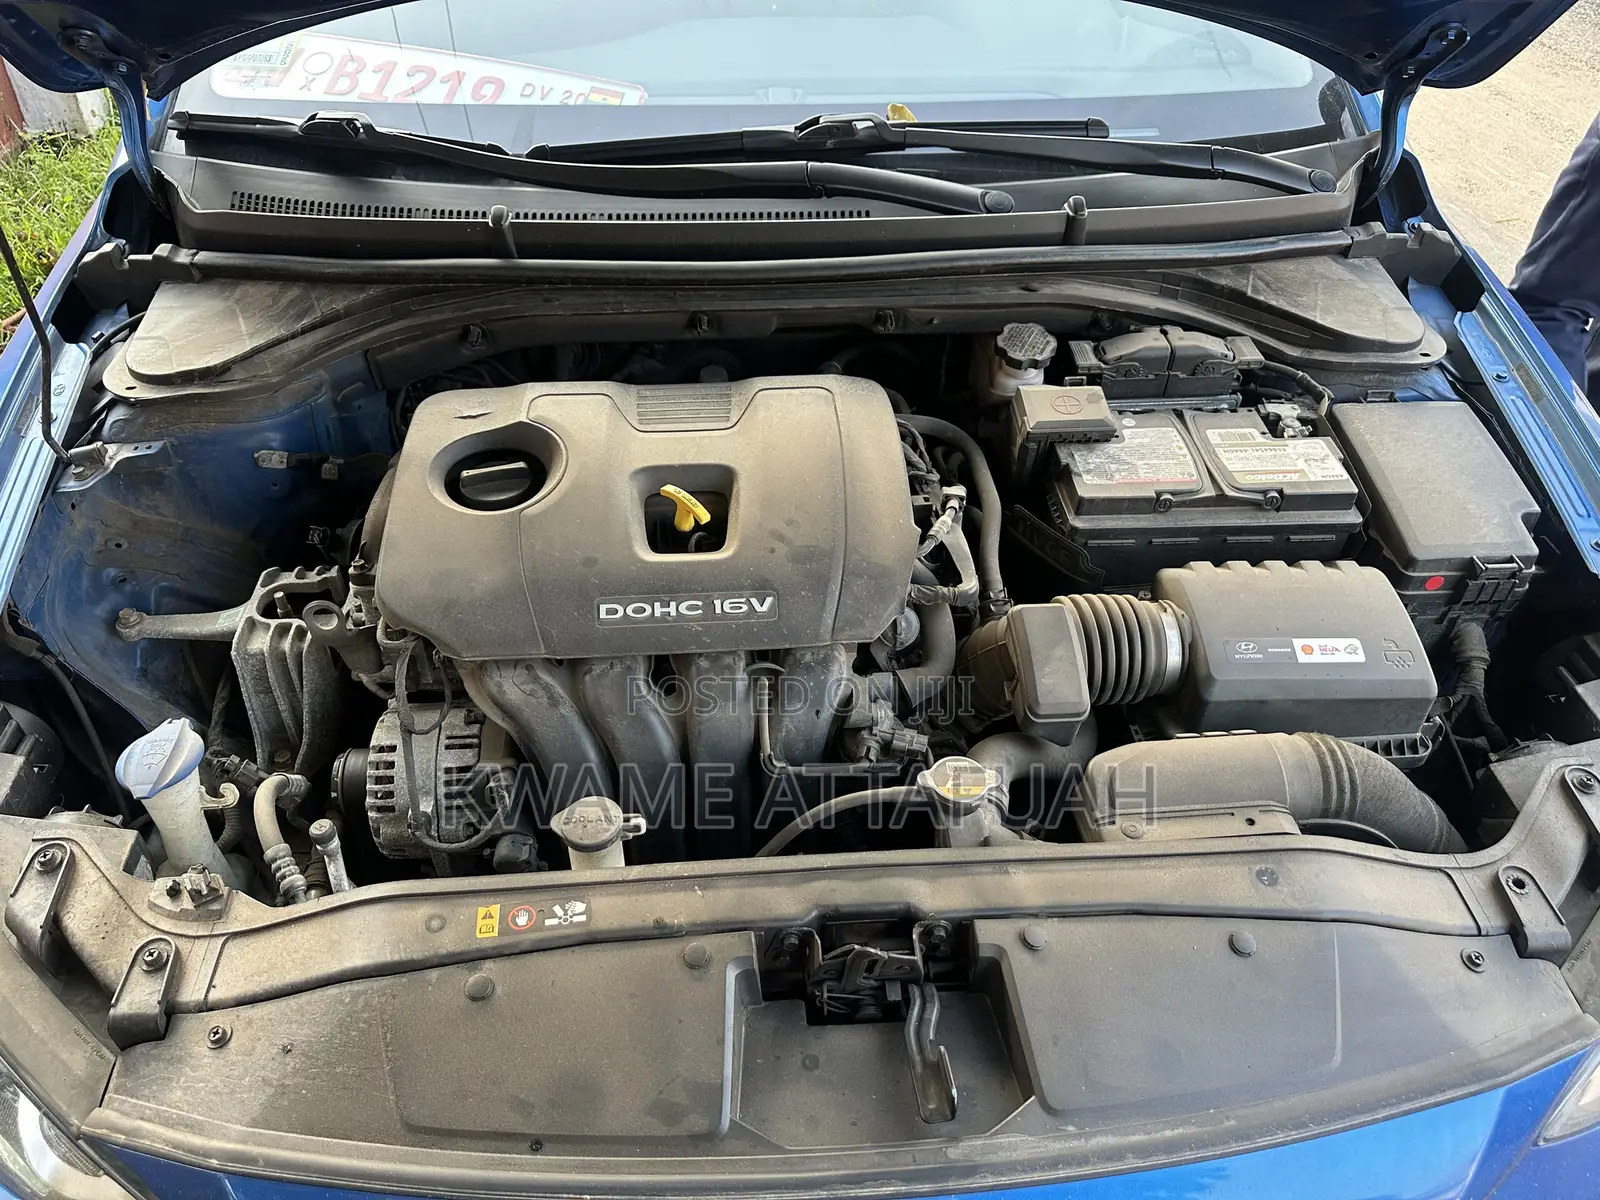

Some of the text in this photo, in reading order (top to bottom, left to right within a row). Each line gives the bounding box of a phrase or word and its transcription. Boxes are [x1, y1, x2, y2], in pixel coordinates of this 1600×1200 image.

[323, 53, 506, 104] B1219
[519, 82, 554, 101] DV
[599, 596, 774, 619] DOHC 16V
[562, 814, 621, 826] COOLANT
